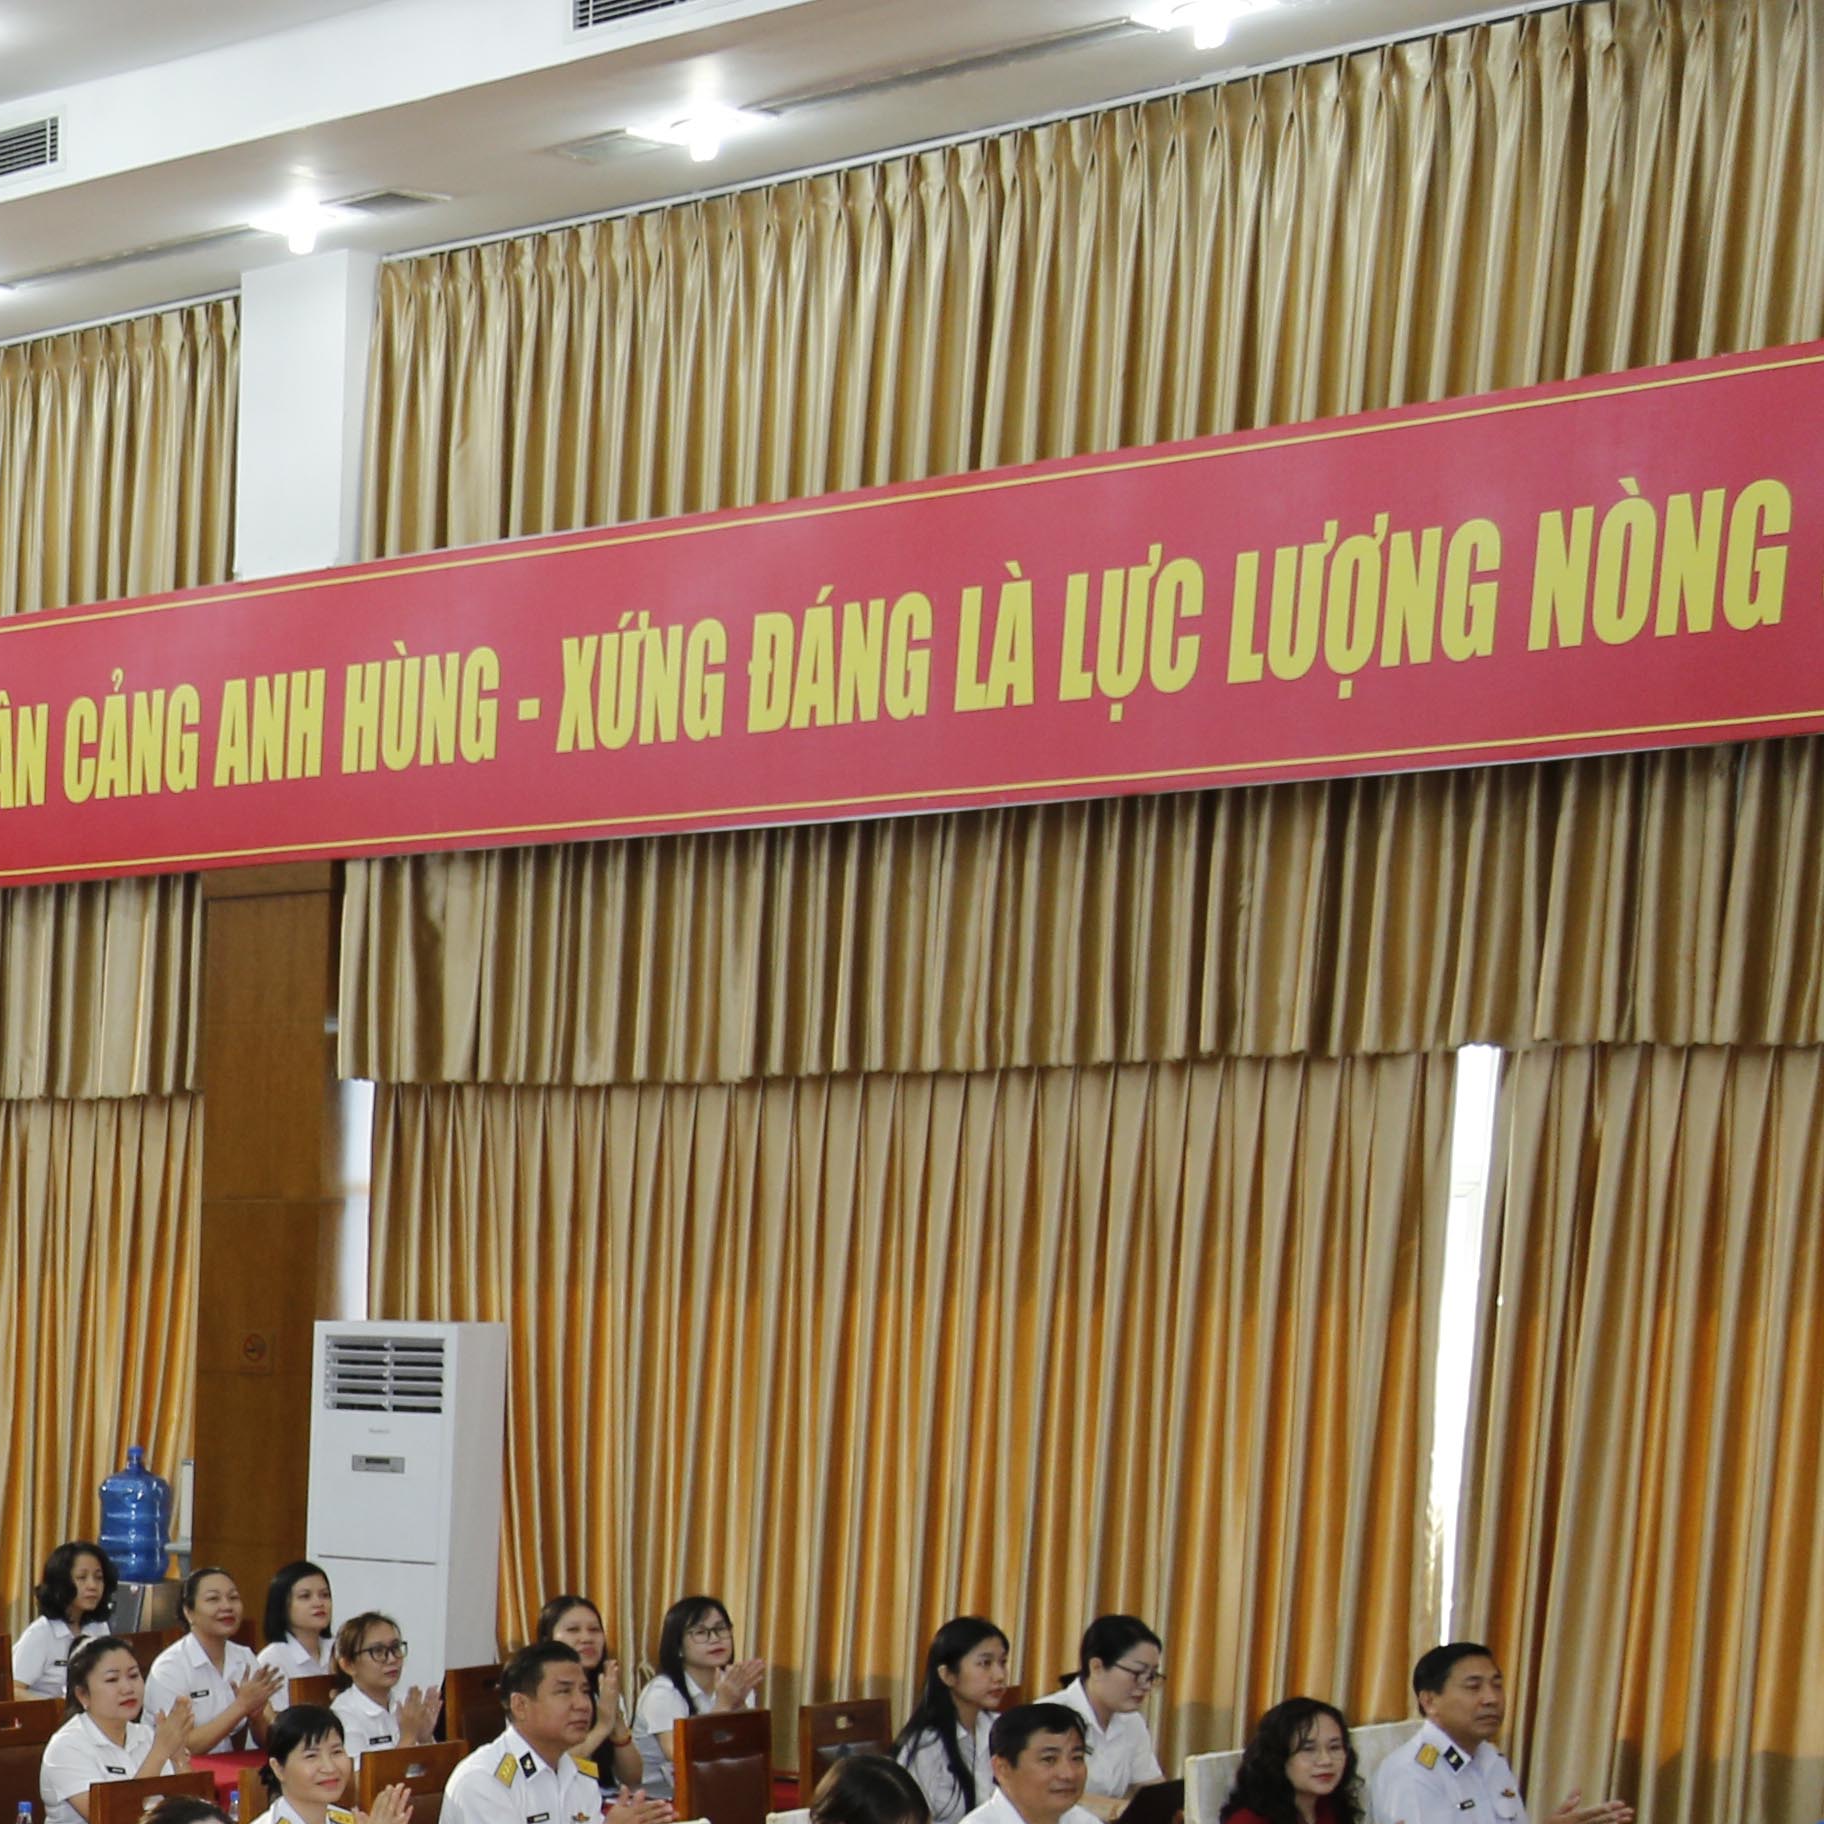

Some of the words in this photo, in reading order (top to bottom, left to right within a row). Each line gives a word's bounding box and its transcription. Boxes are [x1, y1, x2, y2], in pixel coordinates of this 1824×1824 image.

[64, 667, 200, 803] CẢNG
[214, 669, 325, 787] ANH
[342, 640, 500, 776] HÙNG
[557, 611, 727, 752] XỨNG
[748, 585, 932, 732] ĐÁNG
[955, 561, 1034, 711] LÀ
[1060, 544, 1204, 721] LỰC
[1228, 513, 1501, 698] LƯỢNG
[1529, 478, 1792, 650] NÒNG
